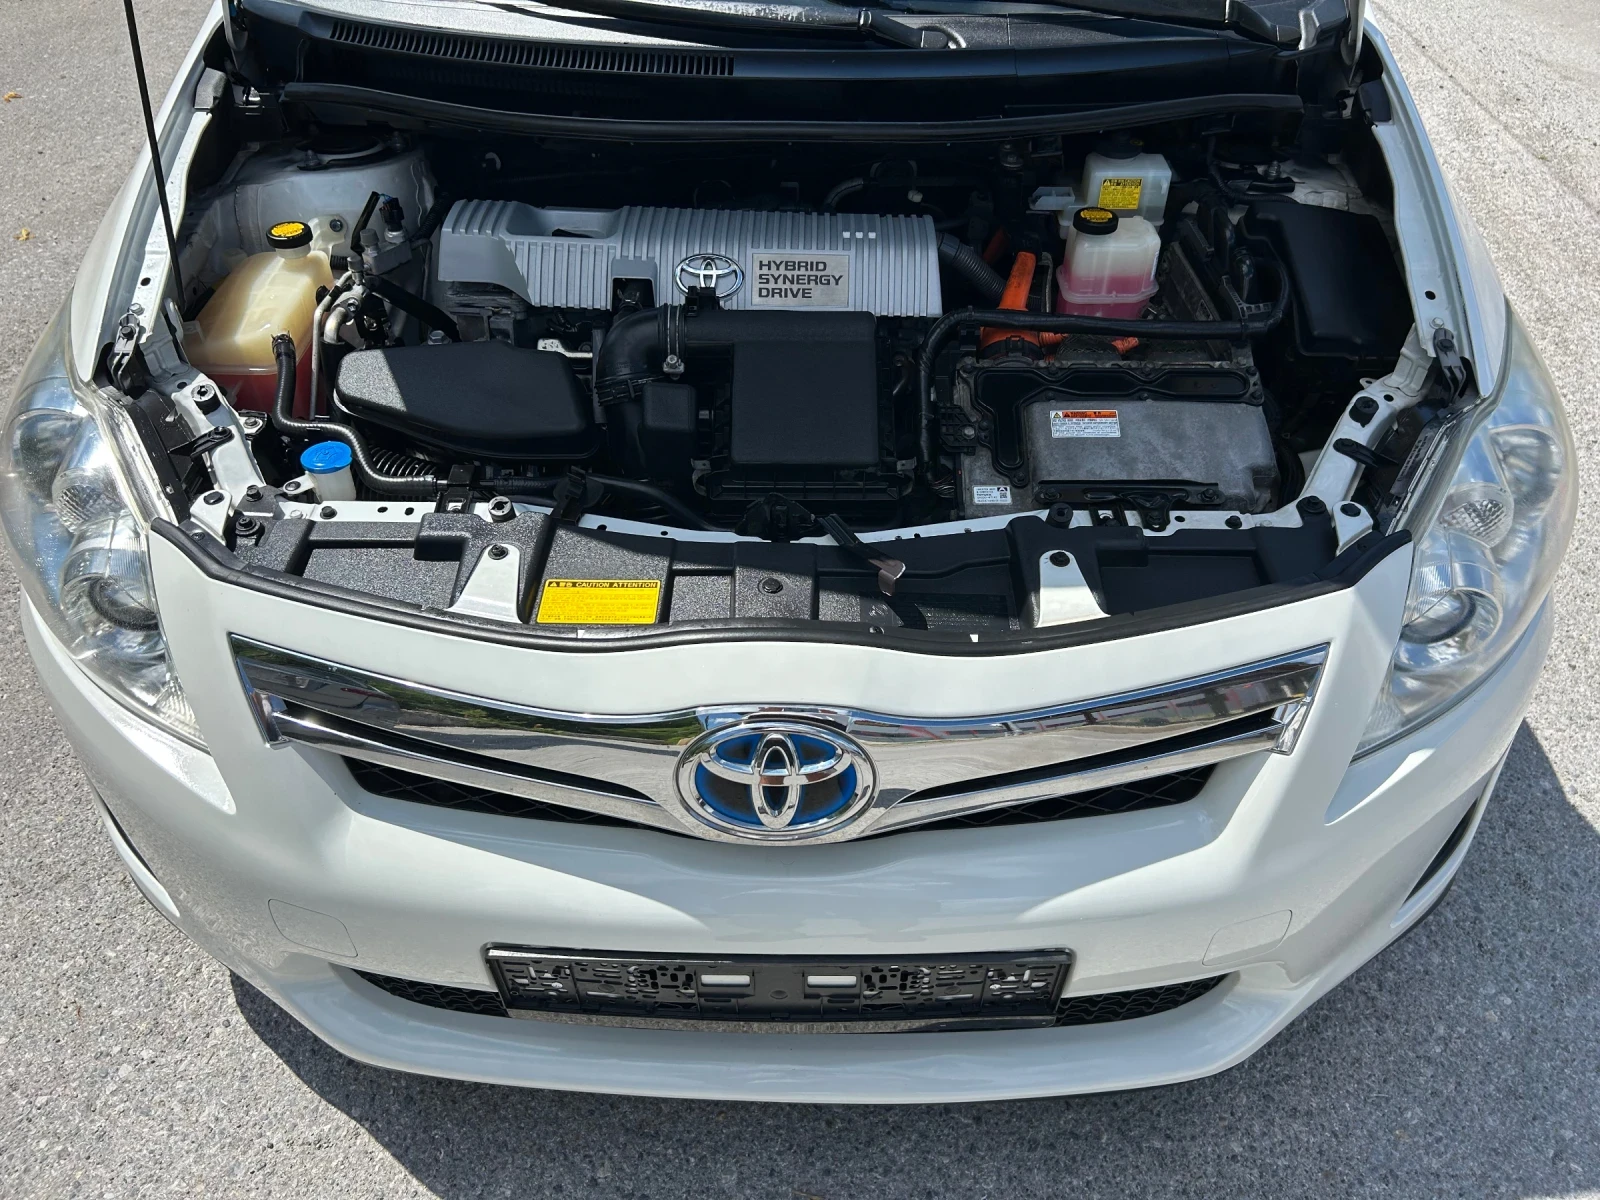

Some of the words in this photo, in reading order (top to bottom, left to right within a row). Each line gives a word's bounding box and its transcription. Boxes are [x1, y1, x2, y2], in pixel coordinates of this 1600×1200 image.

[759, 260, 827, 272] HYBRID
[758, 273, 844, 286] SYNERGY
[758, 287, 812, 299] DRIVE
